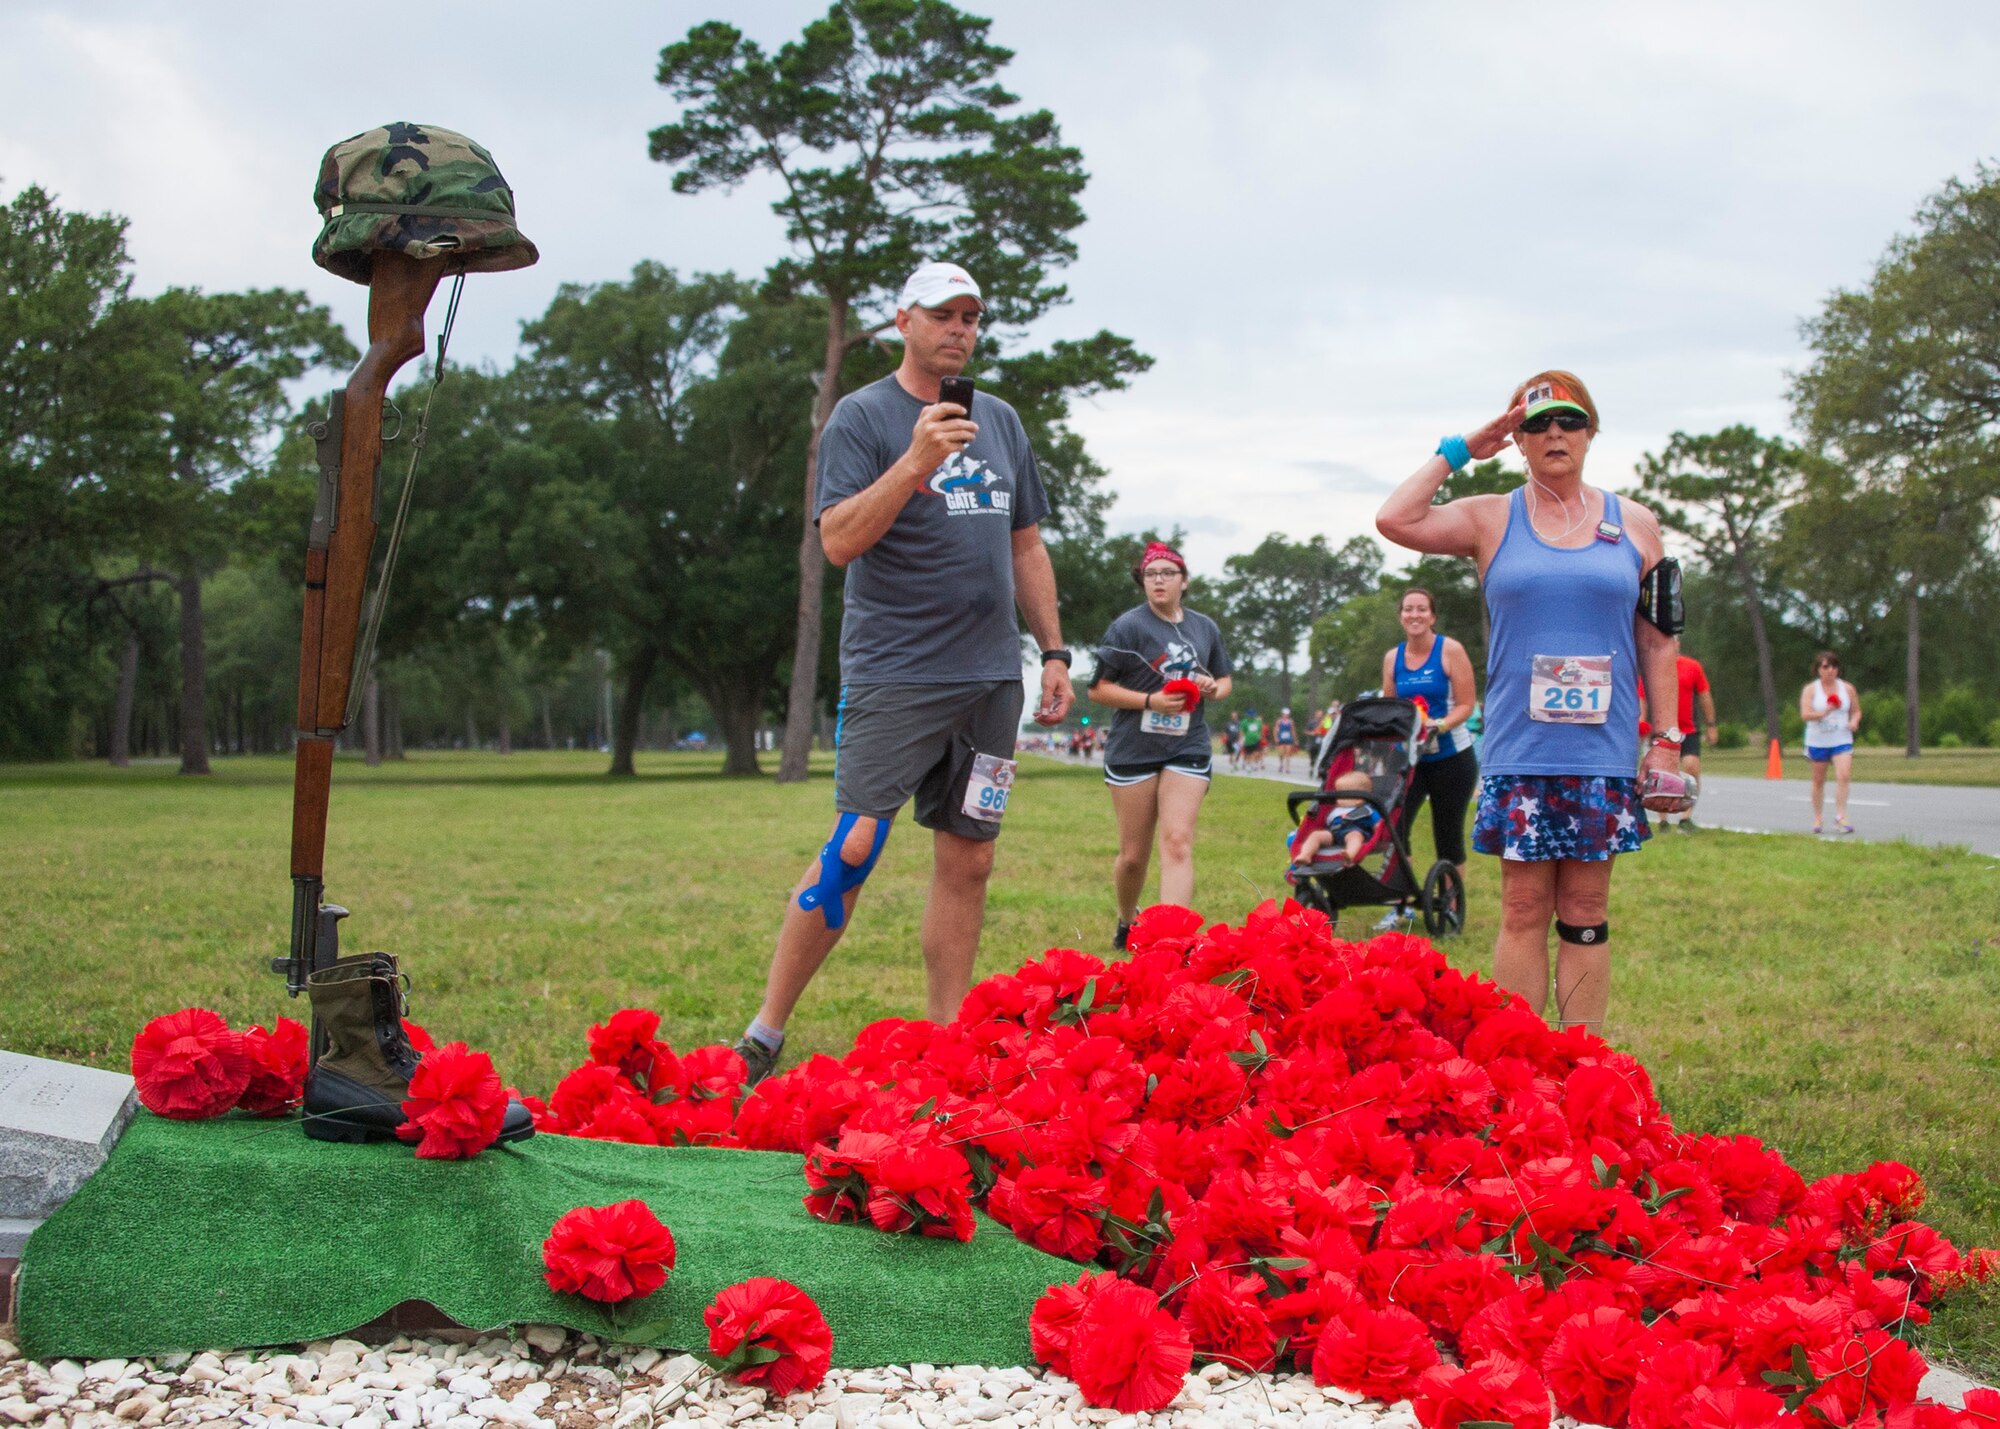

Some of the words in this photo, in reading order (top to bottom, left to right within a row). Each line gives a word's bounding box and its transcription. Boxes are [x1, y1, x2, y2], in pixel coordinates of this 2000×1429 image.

[945, 491, 979, 510] GATE
[990, 490, 1010, 509] GAT
[1543, 687, 1600, 710] 261
[1150, 711, 1183, 728] 563
[979, 786, 1011, 811] 96
